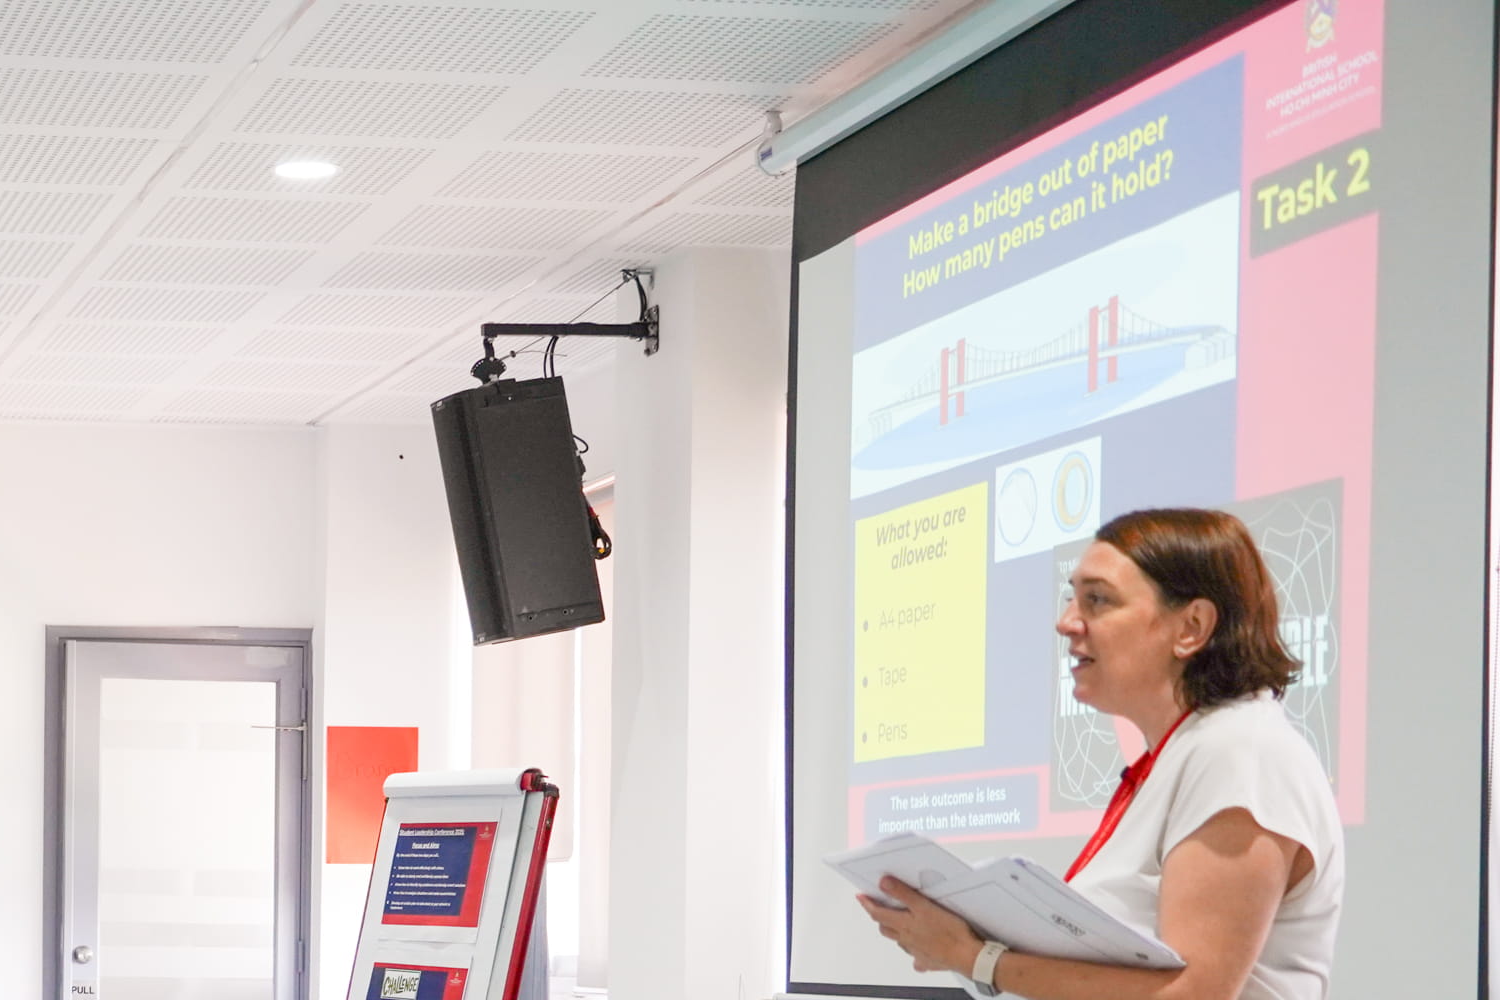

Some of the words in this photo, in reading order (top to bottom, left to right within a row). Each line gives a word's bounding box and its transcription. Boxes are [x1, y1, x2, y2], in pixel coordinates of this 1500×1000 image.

[1302, 52, 1338, 79] BRITISH
[1265, 69, 1336, 110] INTERNATIONAL
[1337, 50, 1379, 78] SCHOOL
[908, 221, 954, 260] Make
[958, 214, 968, 236] a
[973, 181, 1033, 229] bridge
[1038, 159, 1073, 196] out
[1077, 141, 1099, 178] of
[1103, 114, 1169, 174] paper
[1257, 162, 1338, 230] Task
[1347, 148, 1371, 197] 2
[903, 263, 941, 299] How
[945, 237, 994, 279] many
[999, 215, 1045, 262] pens
[1050, 196, 1085, 231] can
[1091, 180, 1106, 213] it
[1111, 149, 1174, 204] hold?
[876, 519, 910, 548] What
[915, 511, 940, 541] you
[943, 506, 966, 527] are
[891, 537, 948, 571] allowed:
[879, 609, 894, 631] A4
[897, 601, 936, 630] paper
[878, 665, 907, 689] Tape
[878, 721, 908, 744] Pens
[890, 796, 908, 811] The
[910, 792, 930, 809] task
[931, 791, 974, 808] outcome
[976, 787, 985, 803] is
[986, 787, 1006, 802] less
[878, 817, 924, 834] important
[926, 815, 948, 831] than
[950, 812, 966, 828] the
[968, 808, 1021, 828] teamwork
[71, 985, 95, 995] PULL
[382, 974, 419, 996] CHALLENGE
